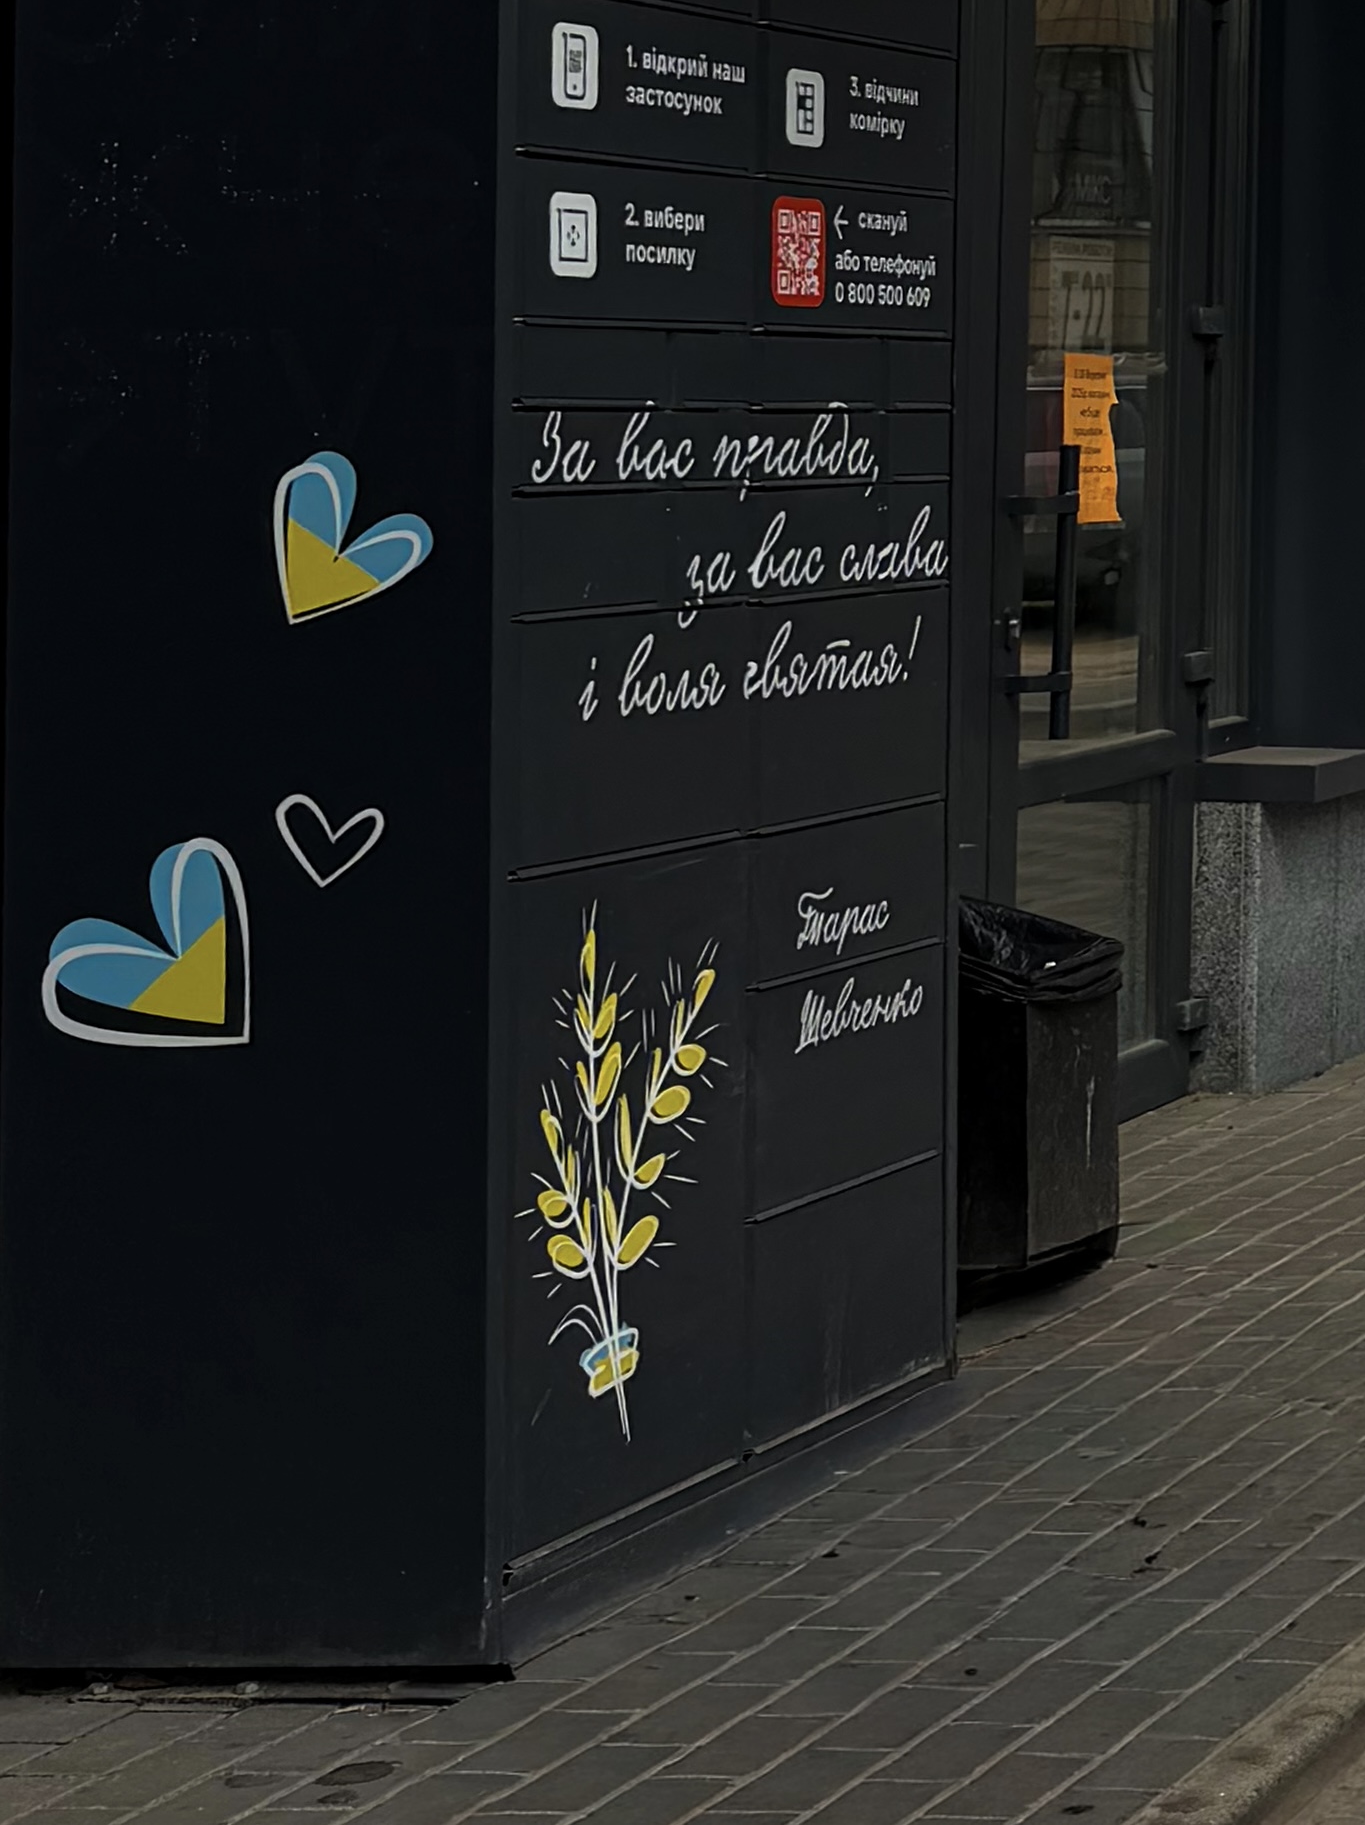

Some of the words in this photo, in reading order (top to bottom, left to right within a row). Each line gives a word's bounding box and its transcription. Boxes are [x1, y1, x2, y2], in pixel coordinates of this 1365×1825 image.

[627, 45, 637, 67] 1.
[643, 47, 707, 79] відкрий
[713, 63, 744, 82] наш
[626, 86, 722, 115] застосунок
[850, 76, 861, 96] 3.
[866, 79, 918, 105] відчини
[850, 112, 905, 139] комірку
[626, 203, 639, 226] 2.
[645, 207, 704, 235] вибери
[859, 211, 907, 236] скануй
[626, 245, 695, 271] посилку
[836, 250, 860, 271] або
[864, 254, 935, 280] телефонуй
[836, 282, 843, 302] 0
[849, 283, 874, 304] 800
[879, 285, 903, 305] 500
[907, 287, 930, 307] 609
[532, 411, 595, 483] За
[616, 401, 694, 480] вас
[713, 402, 878, 501] правда,
[678, 553, 735, 628] за
[748, 511, 824, 588] вас
[840, 506, 948, 581] слава
[579, 658, 598, 721] і
[619, 633, 725, 716] воля
[744, 616, 921, 699] святая!
[797, 888, 889, 955] Тарас
[795, 978, 922, 1053] Шевченко
